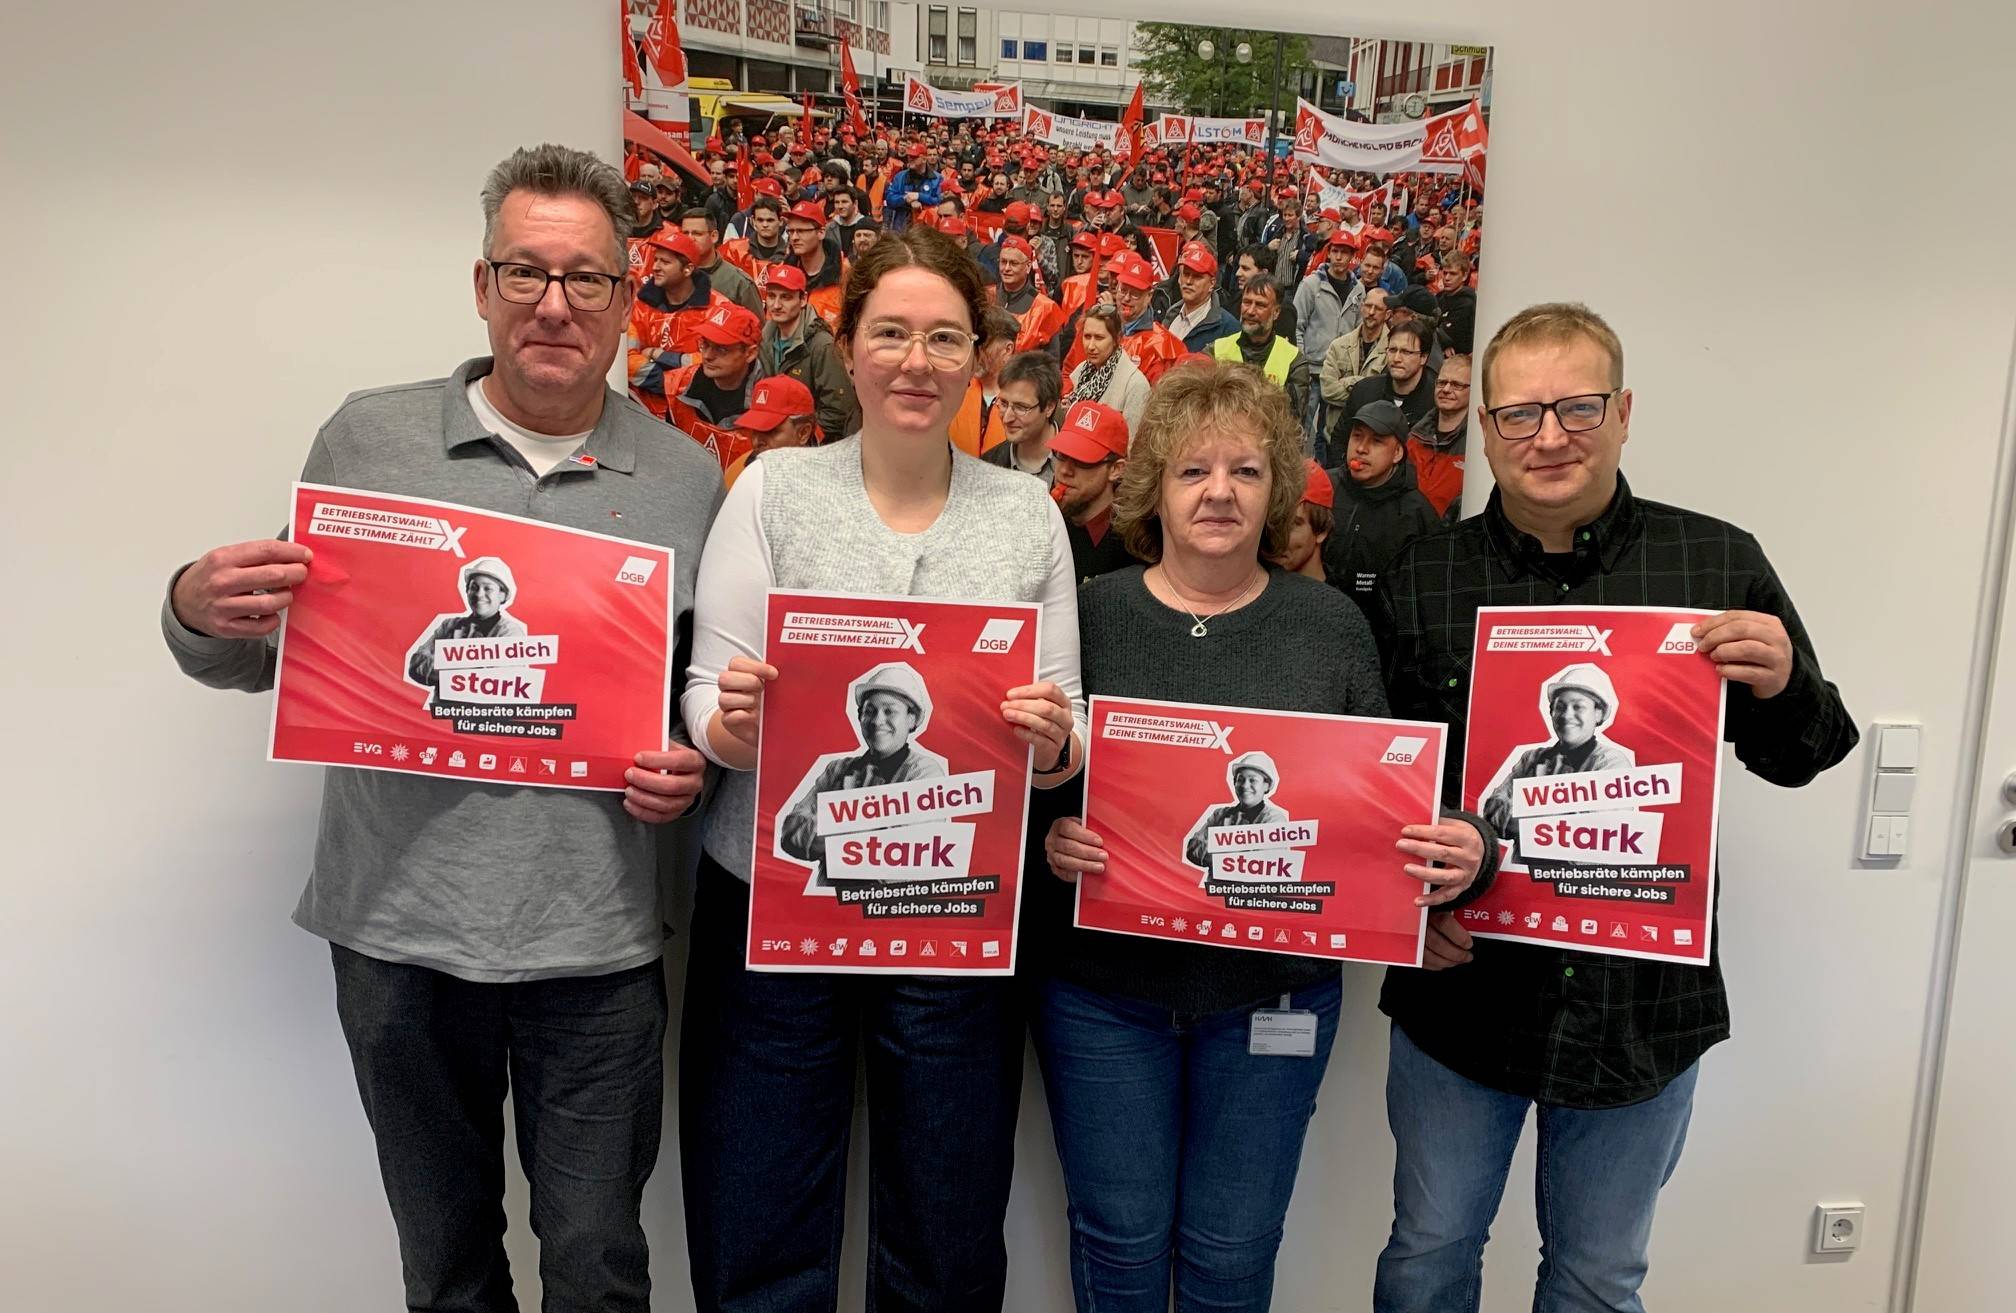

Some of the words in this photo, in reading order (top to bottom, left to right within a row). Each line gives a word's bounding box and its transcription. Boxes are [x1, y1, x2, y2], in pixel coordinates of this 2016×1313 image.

[321, 507, 432, 529] BETRIEBSRATSWAHL:
[317, 523, 351, 534] DEINE
[354, 529, 397, 541] STIMME
[400, 532, 435, 546] ZÄHLT
[620, 570, 645, 584] DGB
[792, 616, 893, 629] BETRIEBSRATSWAHL:
[788, 632, 819, 641] DEINE
[821, 634, 862, 643] STIMME
[864, 634, 896, 645] ZÄHLT
[979, 639, 1008, 651] DGB
[1556, 640, 1584, 648] ZÄHLT
[1664, 641, 1694, 652] DGB
[443, 644, 499, 662] Wähl
[505, 642, 550, 658] dich
[451, 672, 531, 699] stark
[435, 706, 514, 717] Betriebsräte
[516, 706, 572, 719] kämpfen
[458, 720, 476, 730] für
[478, 721, 525, 734] sichere
[527, 725, 557, 736] Jobs
[1113, 715, 1204, 730] BETRIEBSRATSWAHL:
[1109, 728, 1136, 738] DEINE
[1138, 731, 1175, 742] STIMME
[1176, 733, 1206, 745] ZÄHLT
[1386, 752, 1412, 763] DGB
[1523, 780, 1598, 807] Wähl
[1604, 774, 1670, 799] dich
[829, 791, 910, 823] Wähl
[917, 783, 983, 811] dich
[1215, 830, 1264, 846] Wähl
[1269, 827, 1310, 842] dich
[1534, 820, 1644, 854] stark
[842, 835, 956, 868] stark
[1222, 855, 1293, 877] stark
[1534, 868, 1618, 879] Betriebsräte
[1621, 868, 1684, 881] kämpfen
[842, 883, 929, 901] Betriebsräte
[931, 880, 994, 894] kämpfen
[1209, 884, 1278, 894] Betriebsräte
[1280, 884, 1331, 895] kämpfen
[1559, 883, 1578, 894] für
[1581, 884, 1631, 897] sichere
[1634, 888, 1667, 900] Jobs
[867, 903, 888, 915] für
[891, 903, 941, 914] sichere
[944, 903, 977, 913] Jobs
[1229, 897, 1245, 906] für
[1247, 898, 1288, 909] sichere
[1290, 901, 1316, 911] Jobs
